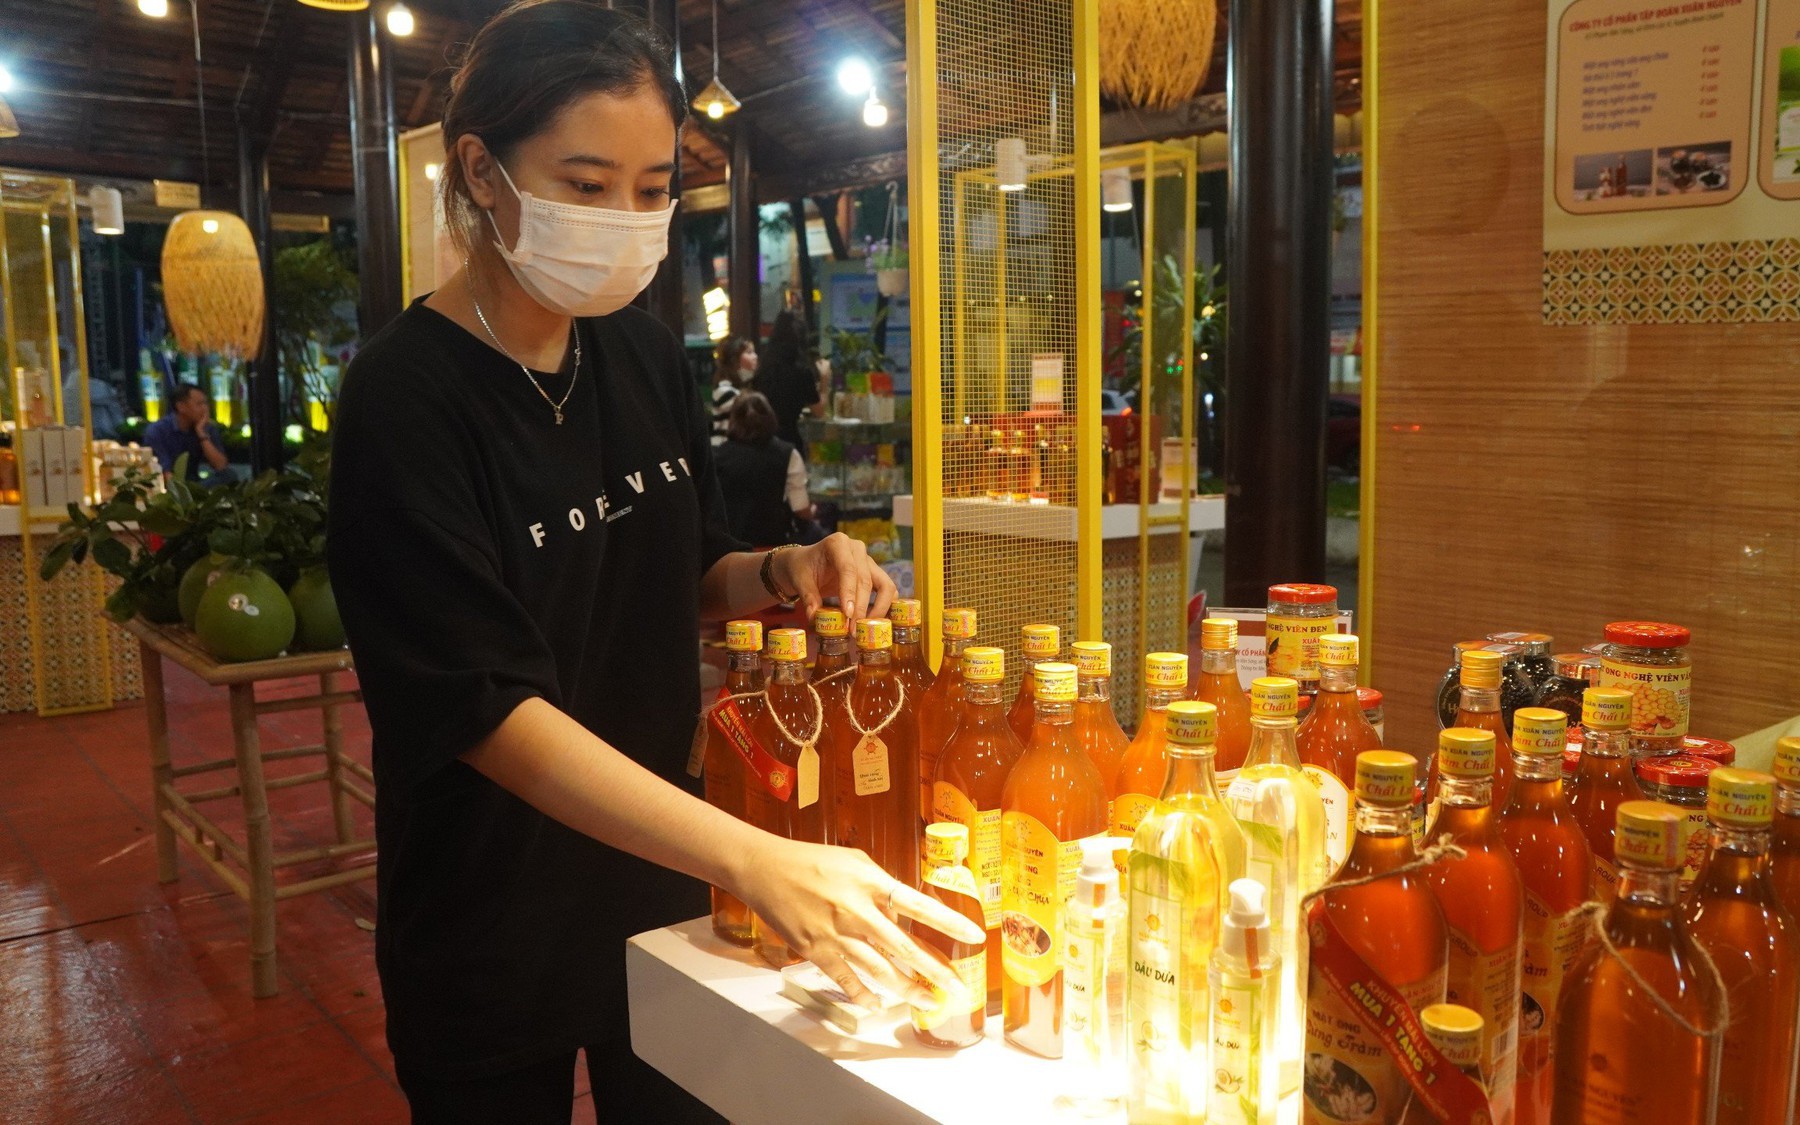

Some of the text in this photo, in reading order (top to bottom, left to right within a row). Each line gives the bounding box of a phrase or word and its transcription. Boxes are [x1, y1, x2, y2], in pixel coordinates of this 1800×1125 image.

[1286, 625, 1308, 633] VIÊN
[1605, 668, 1621, 678] ONG
[1623, 672, 1653, 682] NGHỆ
[1656, 671, 1679, 682] VIÊN
[1350, 982, 1383, 1018] MUA
